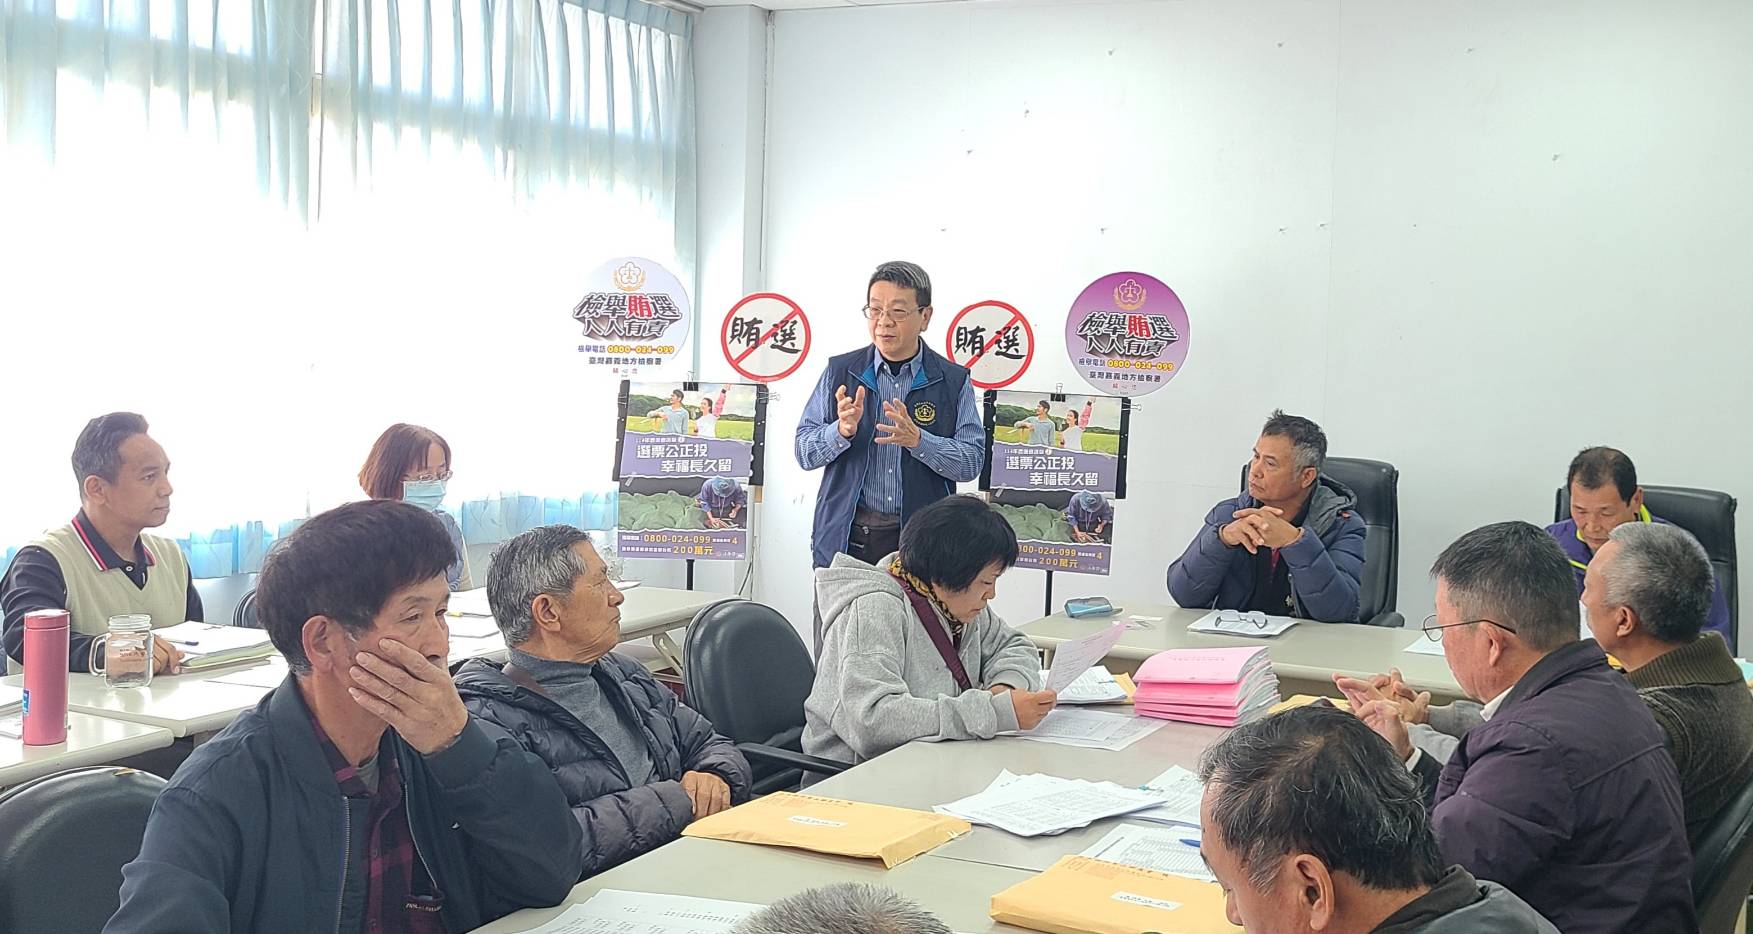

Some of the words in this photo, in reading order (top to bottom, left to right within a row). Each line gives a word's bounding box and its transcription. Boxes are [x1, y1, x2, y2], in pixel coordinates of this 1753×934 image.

[573, 292, 682, 319] 檢舉賄選
[583, 318, 670, 337] 人人有責
[1077, 312, 1179, 340] 檢舉賄選
[607, 345, 675, 354] 0800-024-099
[1086, 335, 1167, 357] 人人有責
[1107, 359, 1175, 371] 0800-024-099
[636, 443, 708, 459] 選票公正投
[660, 458, 732, 473] 幸福長久留
[1005, 456, 1075, 470] 選票公正投
[1029, 471, 1099, 486] 幸福長久留
[643, 534, 711, 543] 0800-024-099
